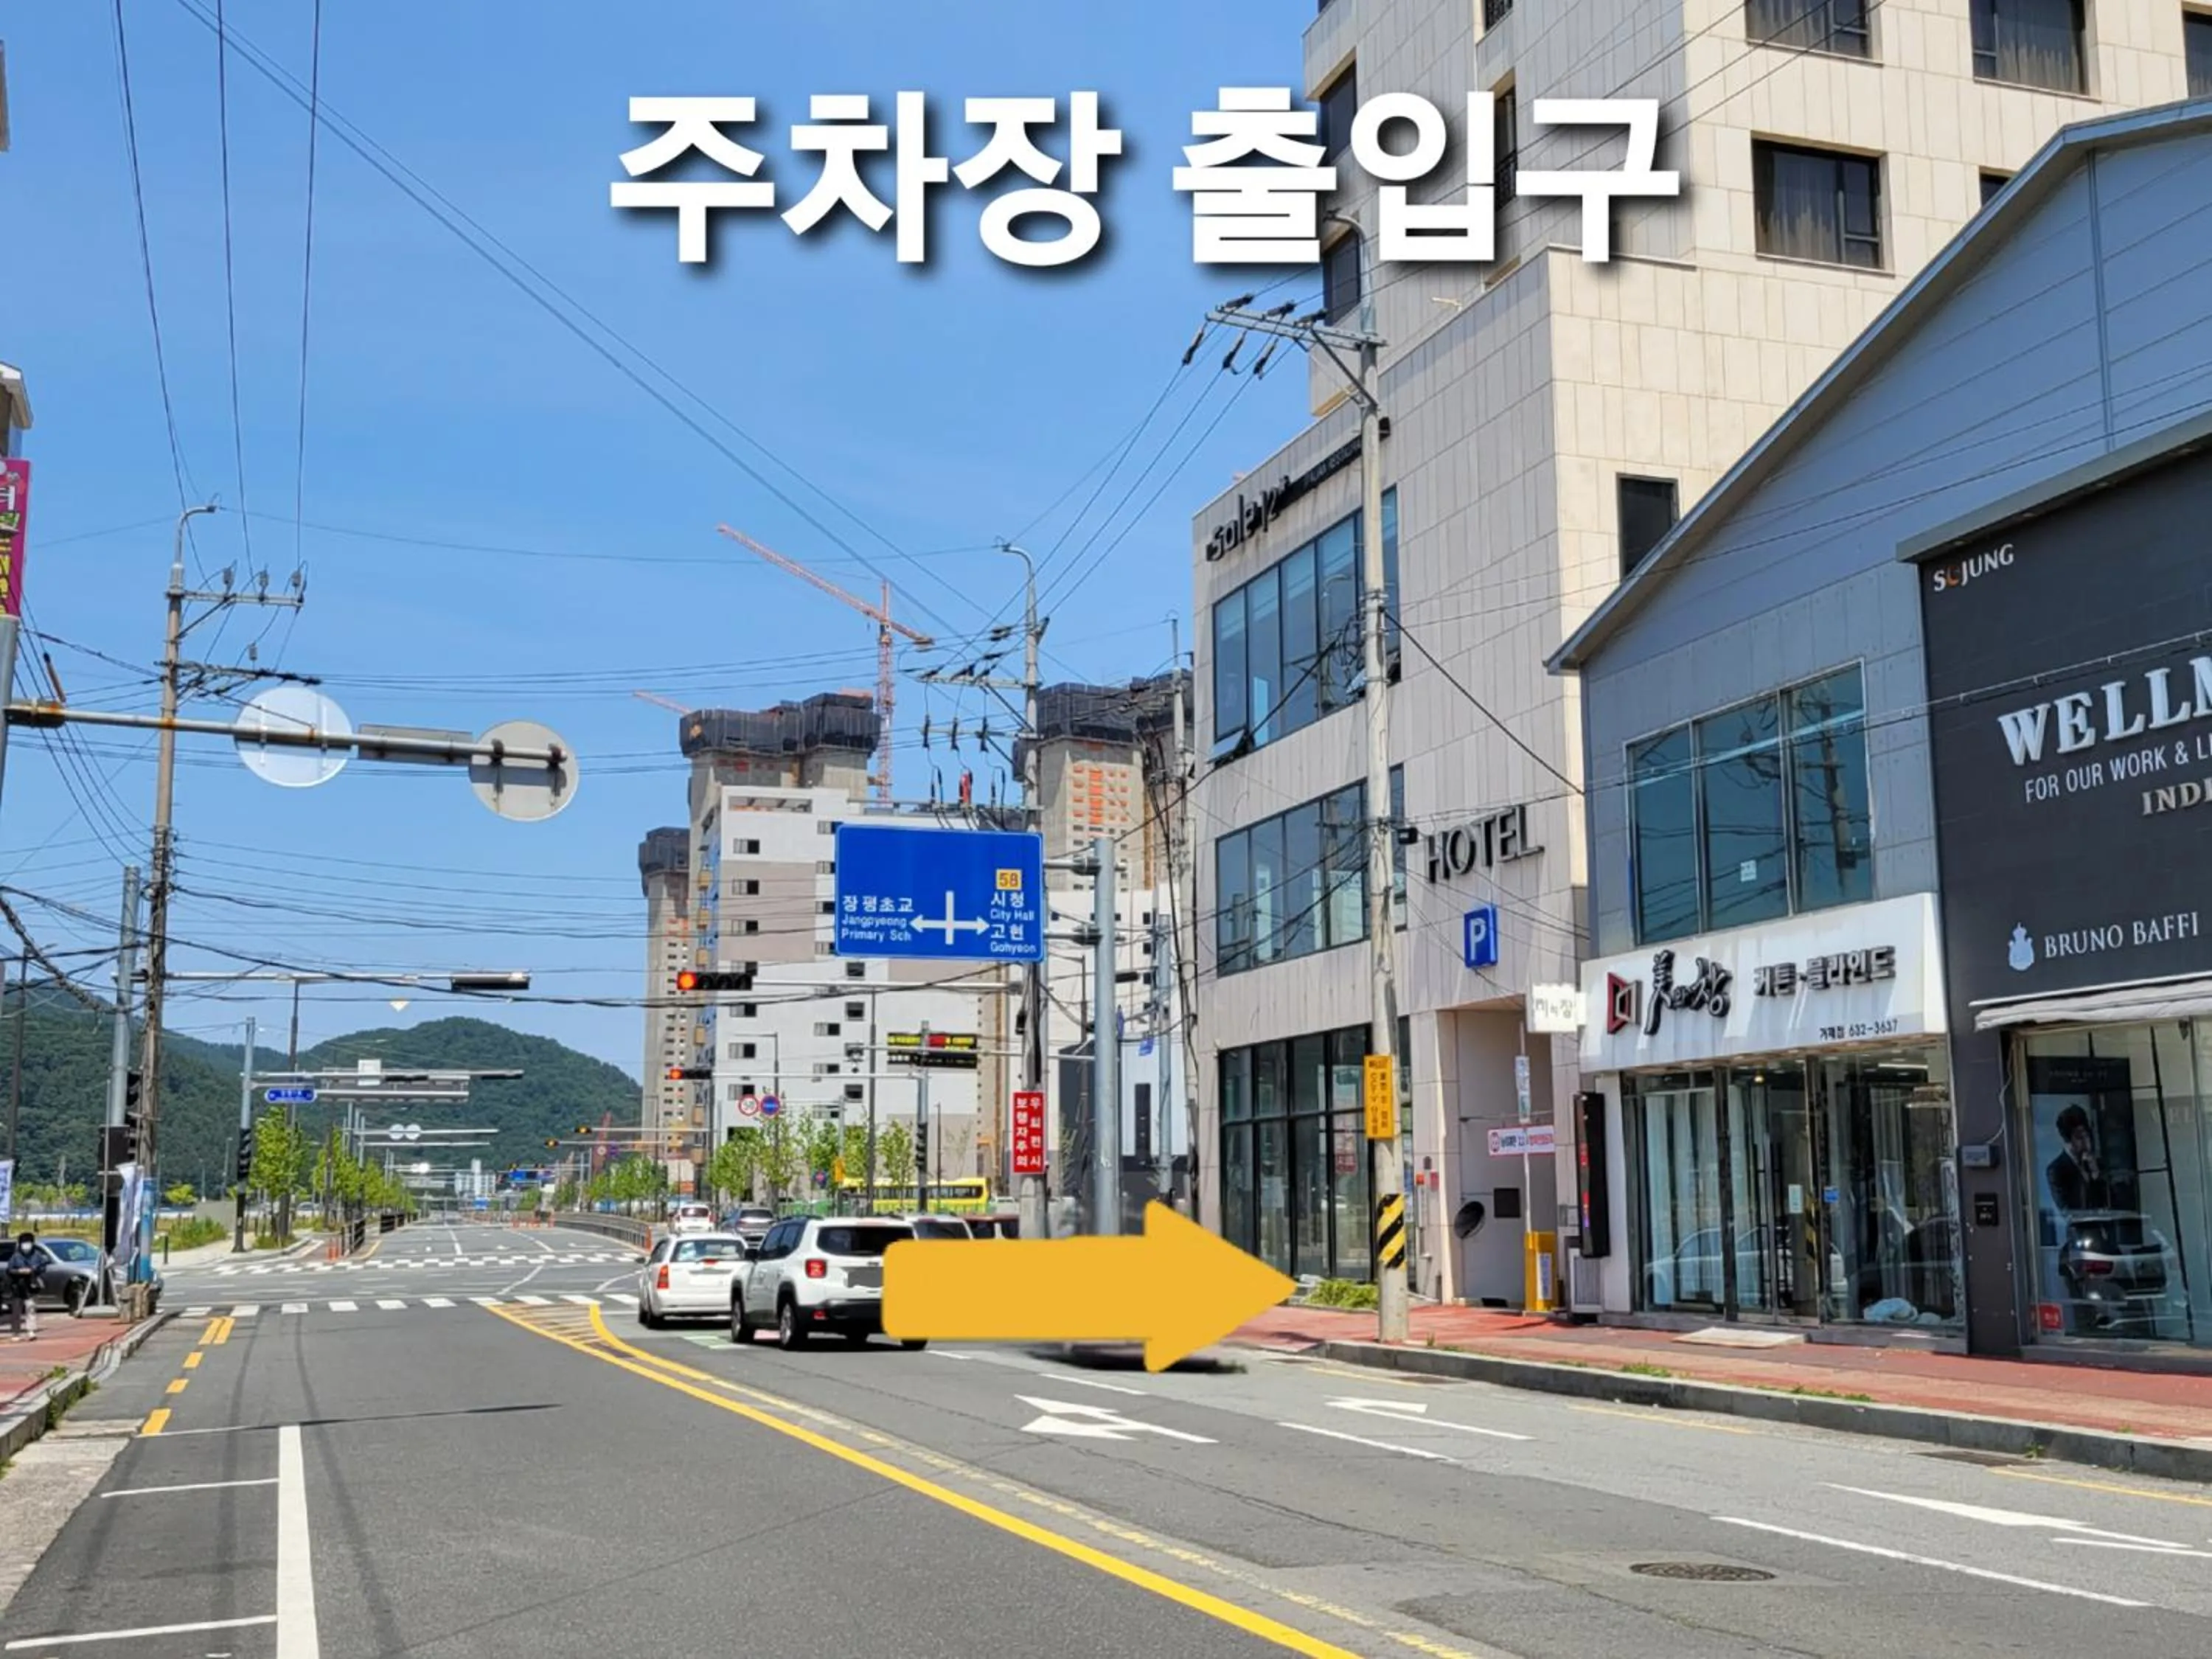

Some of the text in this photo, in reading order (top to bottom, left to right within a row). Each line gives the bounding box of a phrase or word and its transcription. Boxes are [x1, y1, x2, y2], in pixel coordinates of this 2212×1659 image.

[1933, 543, 2014, 592] SOJUNG
[2025, 774, 2060, 804] FOR
[2065, 762, 2104, 793] OUR
[2110, 745, 2168, 782] WORK
[2175, 740, 2189, 765] &
[1425, 804, 1545, 884] HOTEL
[999, 872, 1018, 887] 58
[842, 894, 914, 913] 장평초교
[990, 891, 1025, 908] 시청
[990, 908, 1034, 922] City Hall
[841, 928, 912, 943] Primary Sch
[990, 923, 1024, 941] 고현
[1470, 917, 1486, 961] P
[2044, 911, 2199, 959] BRUNO BAFFI
[990, 942, 1037, 956] Gohyeon
